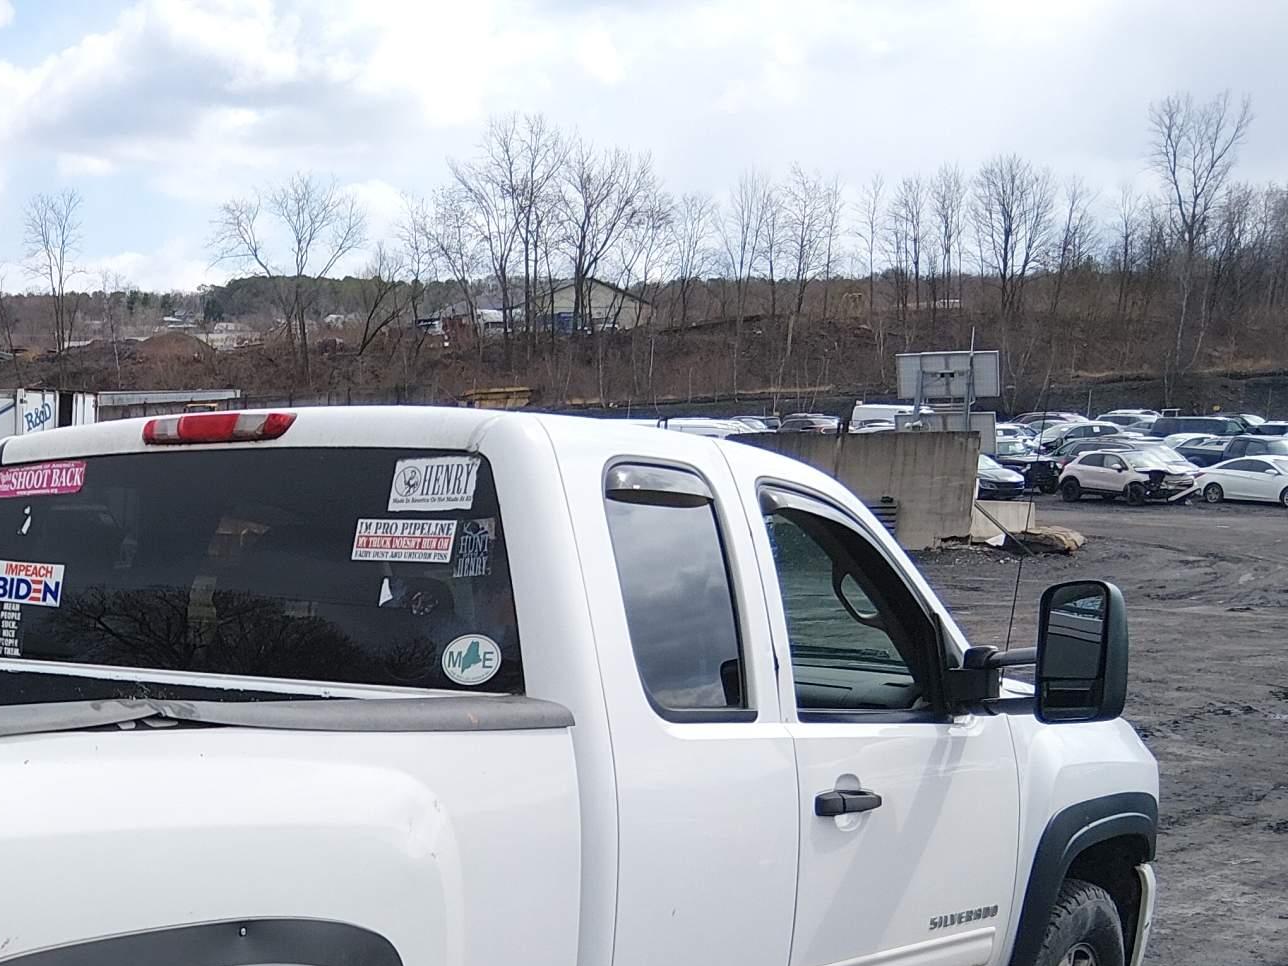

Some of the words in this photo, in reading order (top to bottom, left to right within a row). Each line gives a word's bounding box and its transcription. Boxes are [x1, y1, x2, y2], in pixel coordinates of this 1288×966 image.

[24, 402, 52, 432] R&D
[10, 469, 51, 490] SHOOT
[50, 466, 84, 487] BACK
[420, 463, 477, 496] HENRY
[374, 521, 398, 535] PRO
[399, 521, 455, 536] PIPELINE
[368, 537, 392, 548] TRUCK
[458, 535, 489, 554] HUNT
[372, 551, 389, 559] DUST
[389, 551, 404, 560] AND
[4, 562, 54, 579] IMPEACH
[0, 611, 22, 621] PEOPLE
[929, 904, 999, 930] SILVERADO
